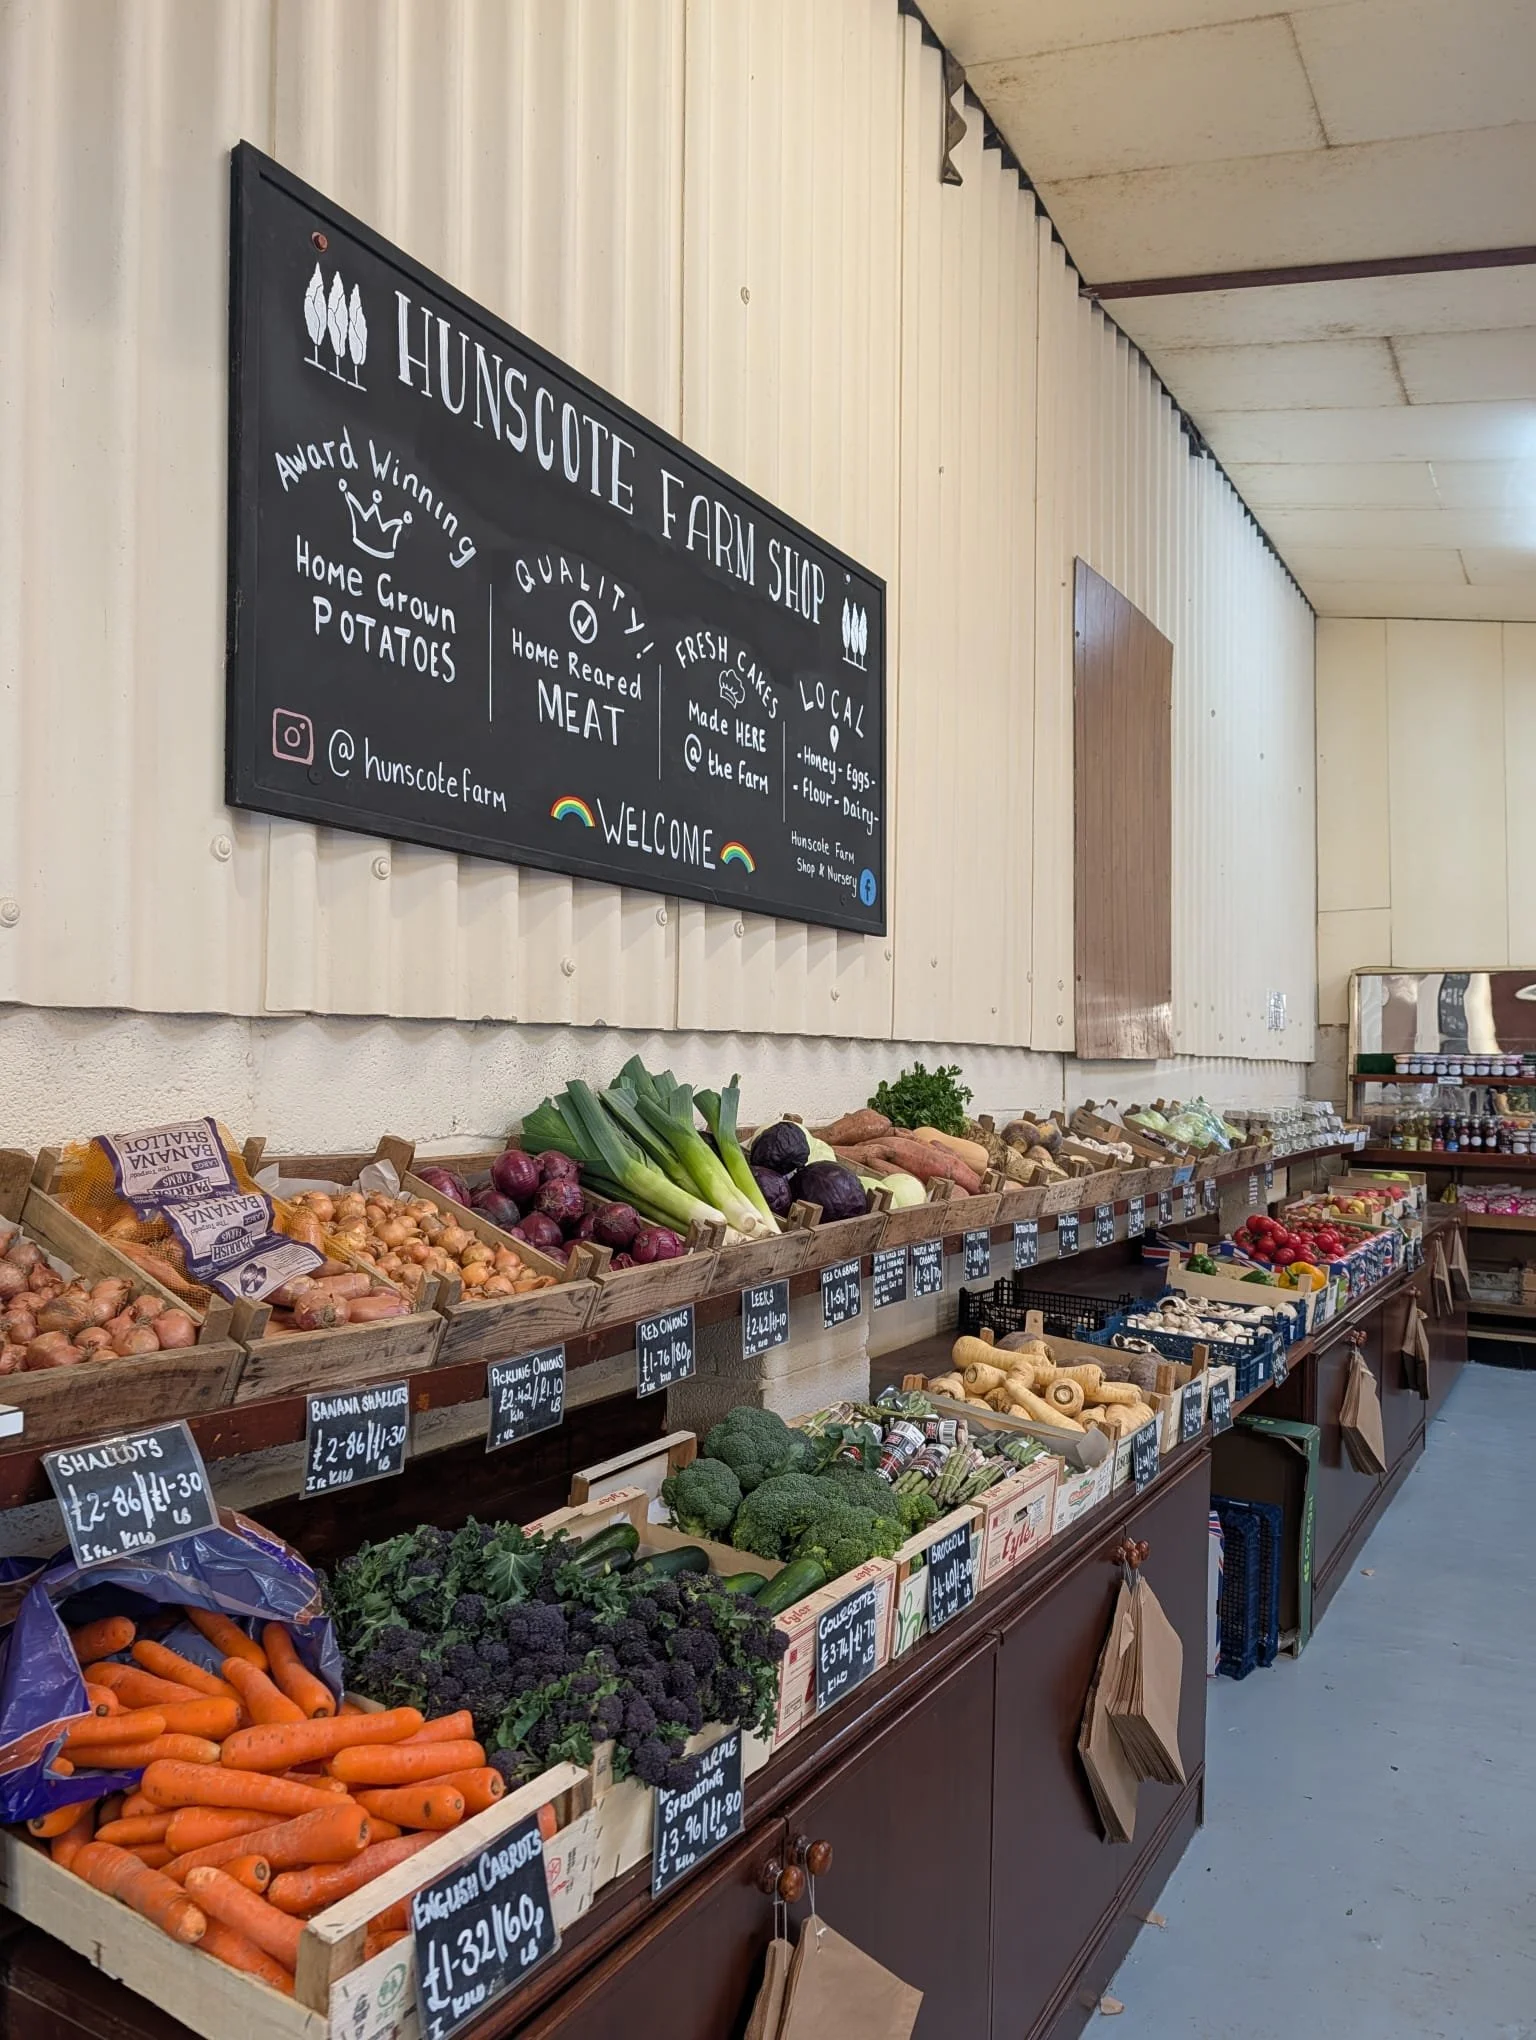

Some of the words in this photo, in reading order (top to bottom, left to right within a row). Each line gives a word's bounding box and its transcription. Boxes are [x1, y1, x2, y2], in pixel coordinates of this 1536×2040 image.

[395, 290, 635, 515] HUNSCOTE
[660, 468, 755, 587] FARM
[768, 537, 825, 625] SHOP
[275, 424, 358, 492] Award
[369, 439, 477, 569] Winning
[377, 573, 456, 634] Grown
[313, 596, 456, 683] POTATOES
[568, 651, 642, 701] Reared
[675, 631, 728, 669] FRESH
[737, 651, 778, 719] CAKES
[538, 678, 625, 746] MEAT
[688, 699, 729, 736] Made
[735, 718, 767, 753] HERE
[799, 679, 864, 739] LOCAL
[708, 748, 733, 780] the
[596, 797, 716, 870] WELCOME
[791, 830, 830, 856] Hunscote
[796, 857, 816, 878] Shop
[827, 864, 858, 898] Nursery
[123, 1130, 209, 1154] SHALLOT
[126, 1143, 215, 1170] BANANA
[162, 1171, 194, 1186] FARMS
[183, 1195, 262, 1225] BANANA
[212, 1236, 253, 1259] PARRISH
[751, 1288, 774, 1308] LEEKS
[822, 1272, 833, 1284] RED
[641, 1322, 659, 1342] RED
[659, 1310, 688, 1334] ONIONS
[311, 1396, 361, 1422] BANANA
[361, 1386, 408, 1412] SHALLOTS
[57, 1437, 164, 1477] SHALLOTS
[931, 1529, 966, 1565] BROCCOLI
[664, 1767, 725, 1824] SPROUTING
[413, 1872, 479, 1930] ENGLISH
[478, 1828, 542, 1892] CARROTS
